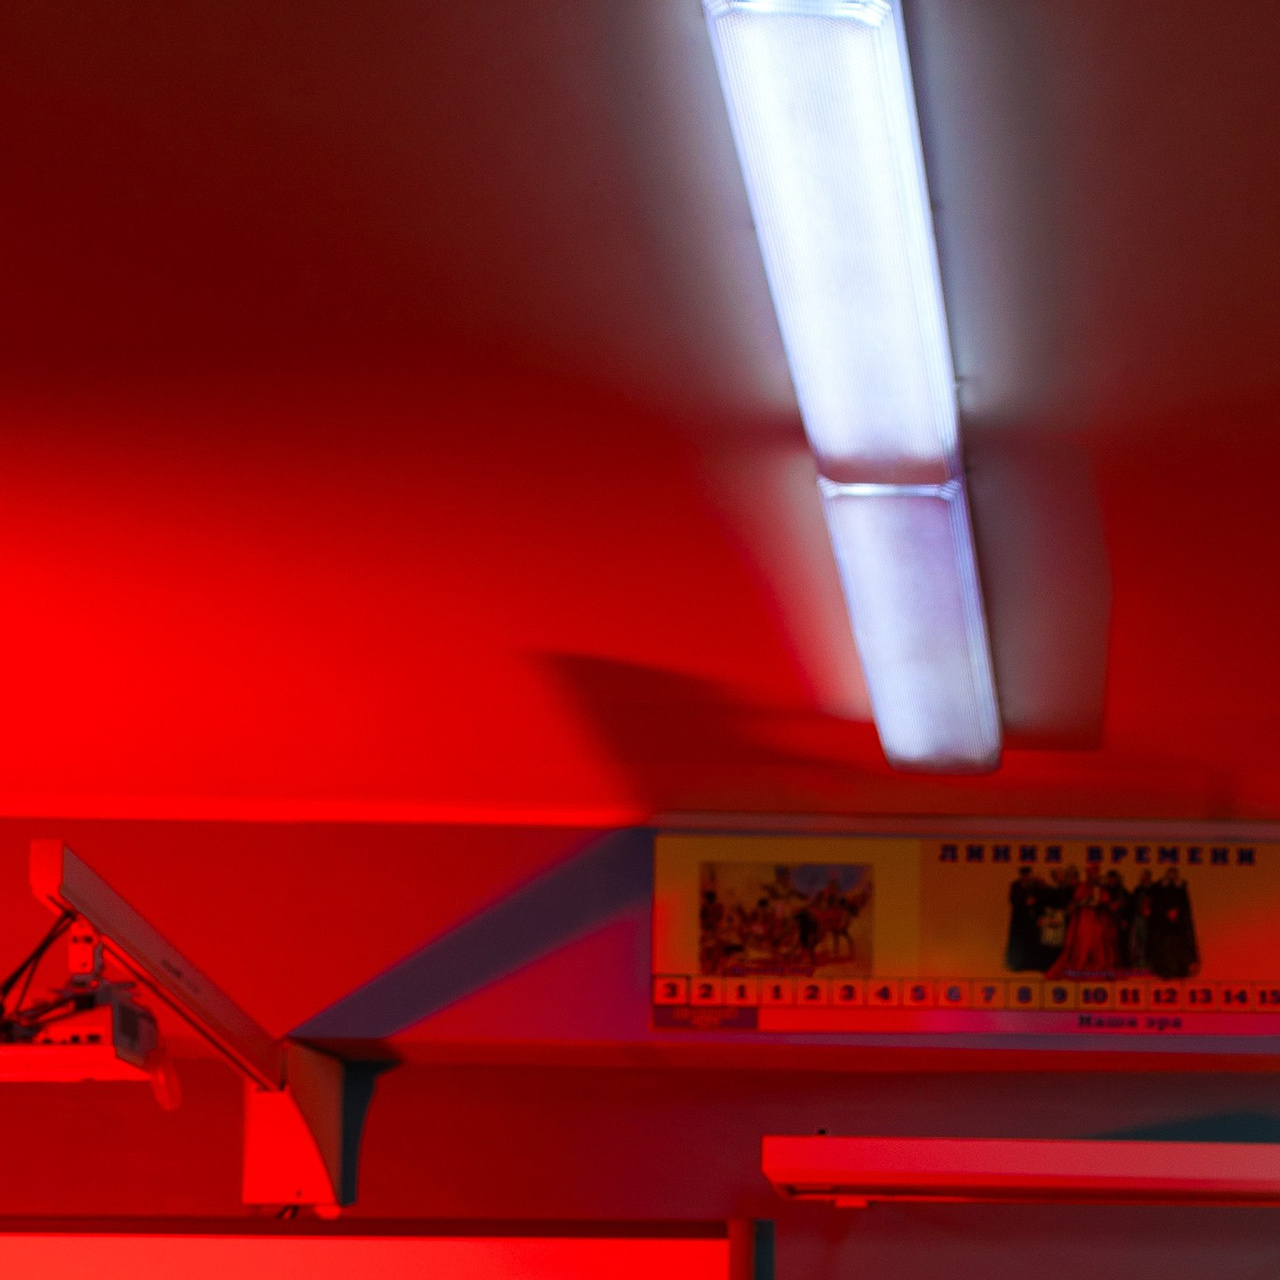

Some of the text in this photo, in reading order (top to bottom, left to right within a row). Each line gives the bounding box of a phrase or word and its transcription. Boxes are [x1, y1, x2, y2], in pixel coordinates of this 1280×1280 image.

[938, 844, 1257, 865] ЛИНИЯ ВРЕМЕНИ
[664, 984, 678, 999] 3
[700, 984, 714, 999] 2
[737, 984, 747, 1000] 1
[771, 984, 782, 1000] 1
[806, 984, 820, 1000] 2
[841, 985, 855, 1000] 3
[876, 985, 891, 1001] 4
[912, 985, 926, 1001] 5
[947, 985, 961, 1001] 6
[982, 986, 996, 1002] 7
[1017, 986, 1032, 1002] 8
[1052, 986, 1067, 1002] 9
[1083, 988, 1107, 1004] 10
[1120, 988, 1141, 1004] 11
[1153, 988, 1178, 1004] 12
[1189, 988, 1213, 1004] 13
[1223, 989, 1248, 1004] 14
[1077, 1013, 1183, 1031] Наша эра
